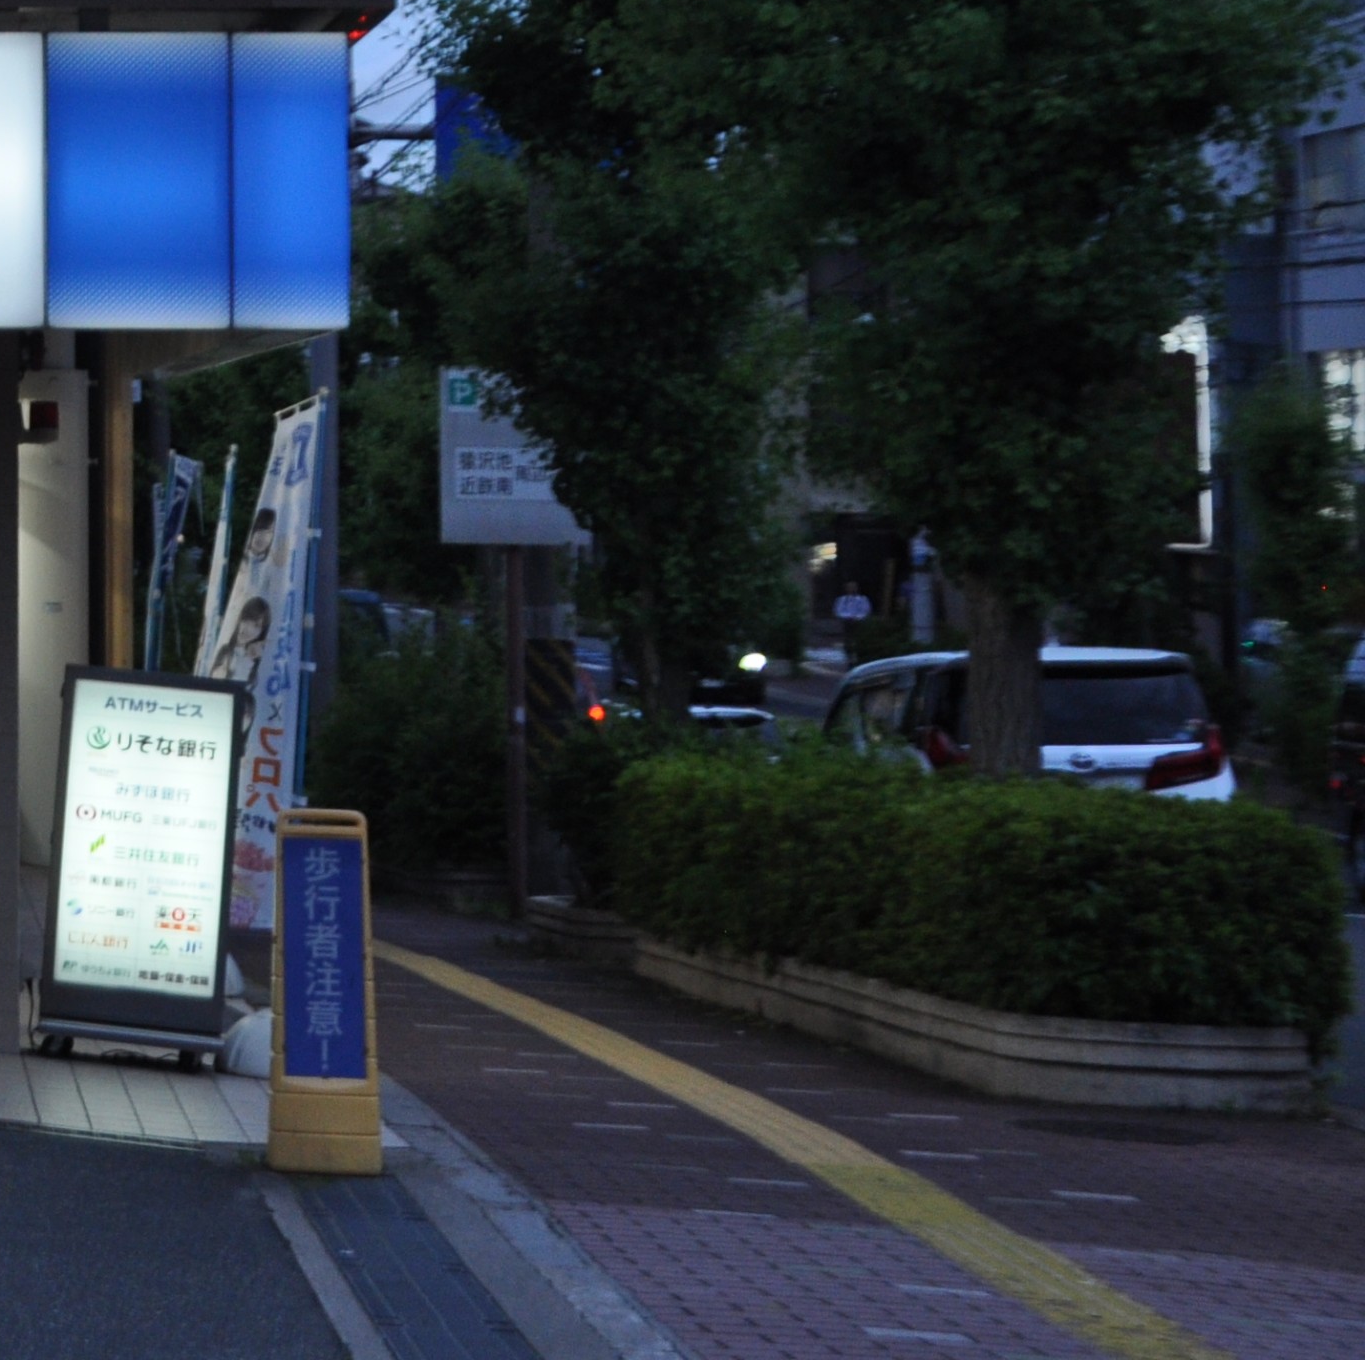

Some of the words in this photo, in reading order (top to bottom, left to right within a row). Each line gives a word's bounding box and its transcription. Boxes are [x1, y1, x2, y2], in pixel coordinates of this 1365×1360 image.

[105, 696, 203, 718] ATMサービス
[117, 732, 217, 760] りそな銀行
[100, 808, 142, 824] MUFG
